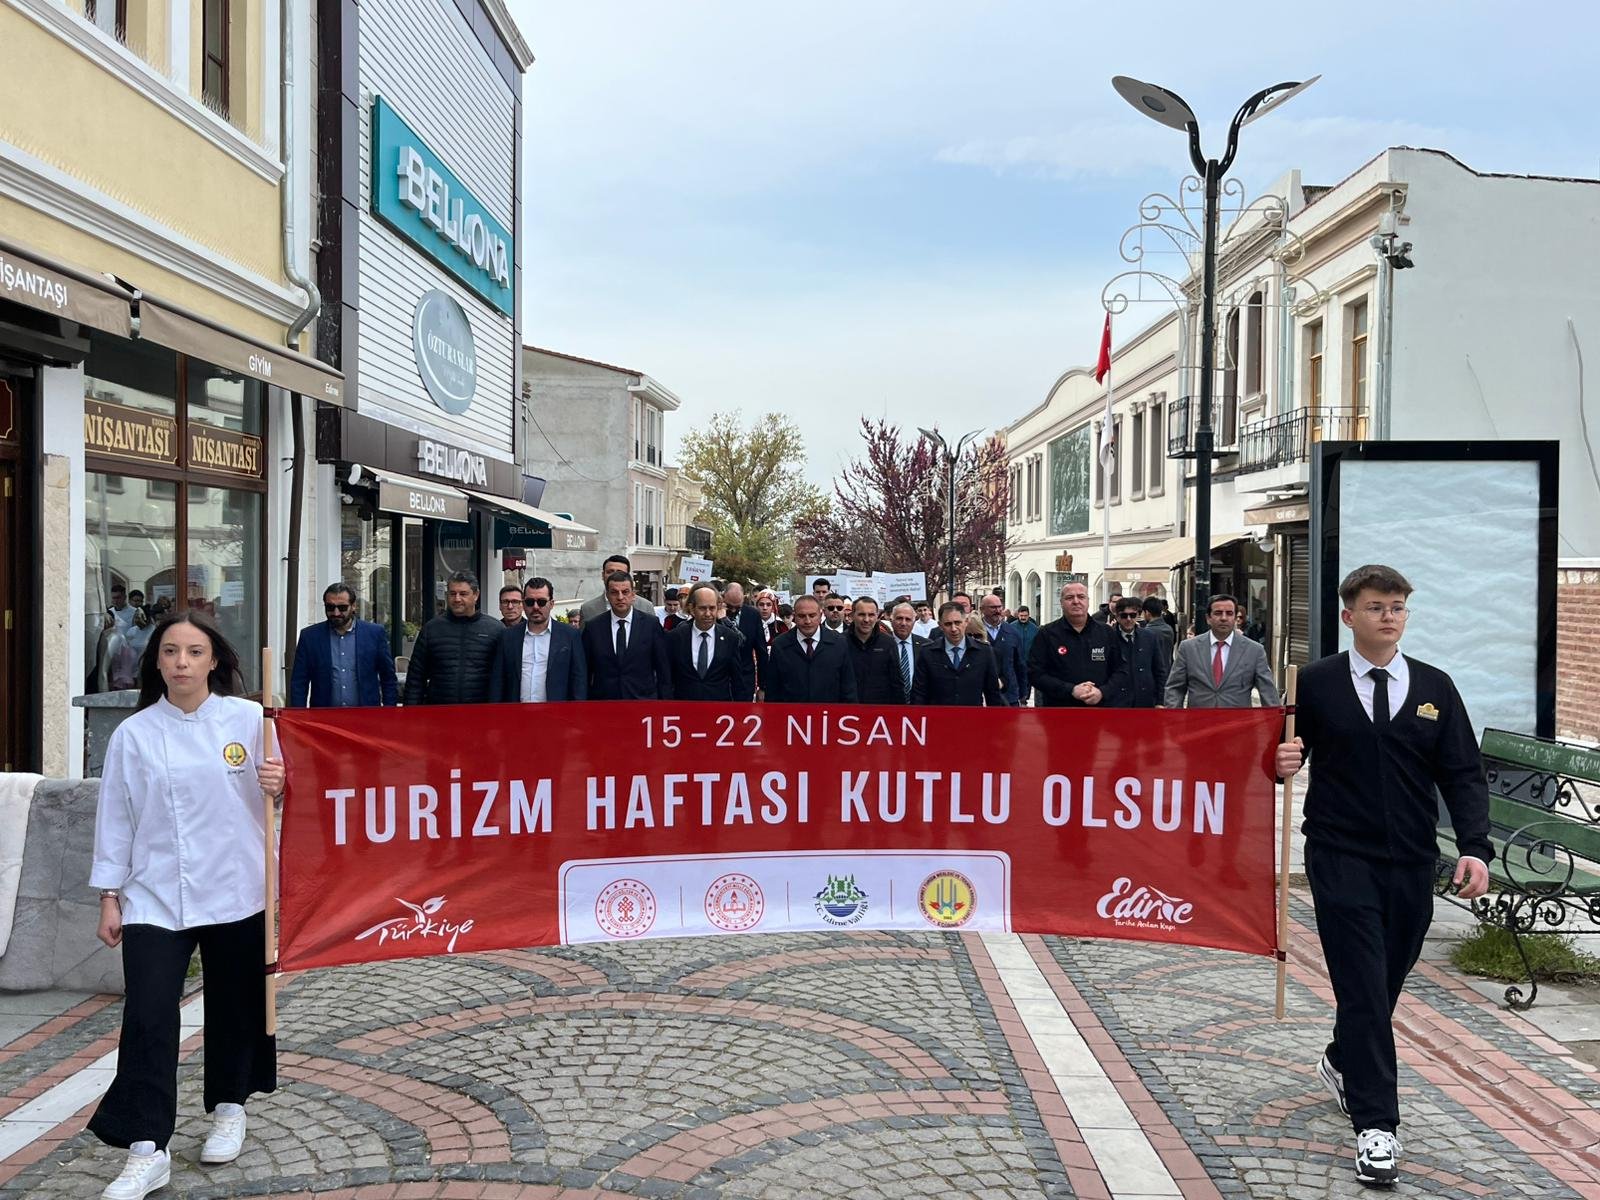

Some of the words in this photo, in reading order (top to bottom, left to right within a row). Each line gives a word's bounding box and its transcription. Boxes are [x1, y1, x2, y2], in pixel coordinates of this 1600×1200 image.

[397, 146, 509, 288] BELLONA
[0, 257, 67, 308] İŞANTAŞI
[249, 354, 272, 377] GİYİM
[84, 407, 170, 460] NİŞANTAŞI
[192, 429, 257, 474] NİŞANTAŞI
[417, 440, 487, 487] BELLONA
[409, 492, 446, 513] BELLONA
[642, 715, 762, 748] 15-22
[786, 711, 927, 746] NİSAN
[325, 769, 552, 845] TURİZM
[586, 771, 809, 830] HAFTASI
[841, 771, 1011, 825] KUTLU
[1042, 774, 1225, 835] OLSUN
[1096, 877, 1193, 924] Edirne
[354, 906, 474, 953] Türkiye
